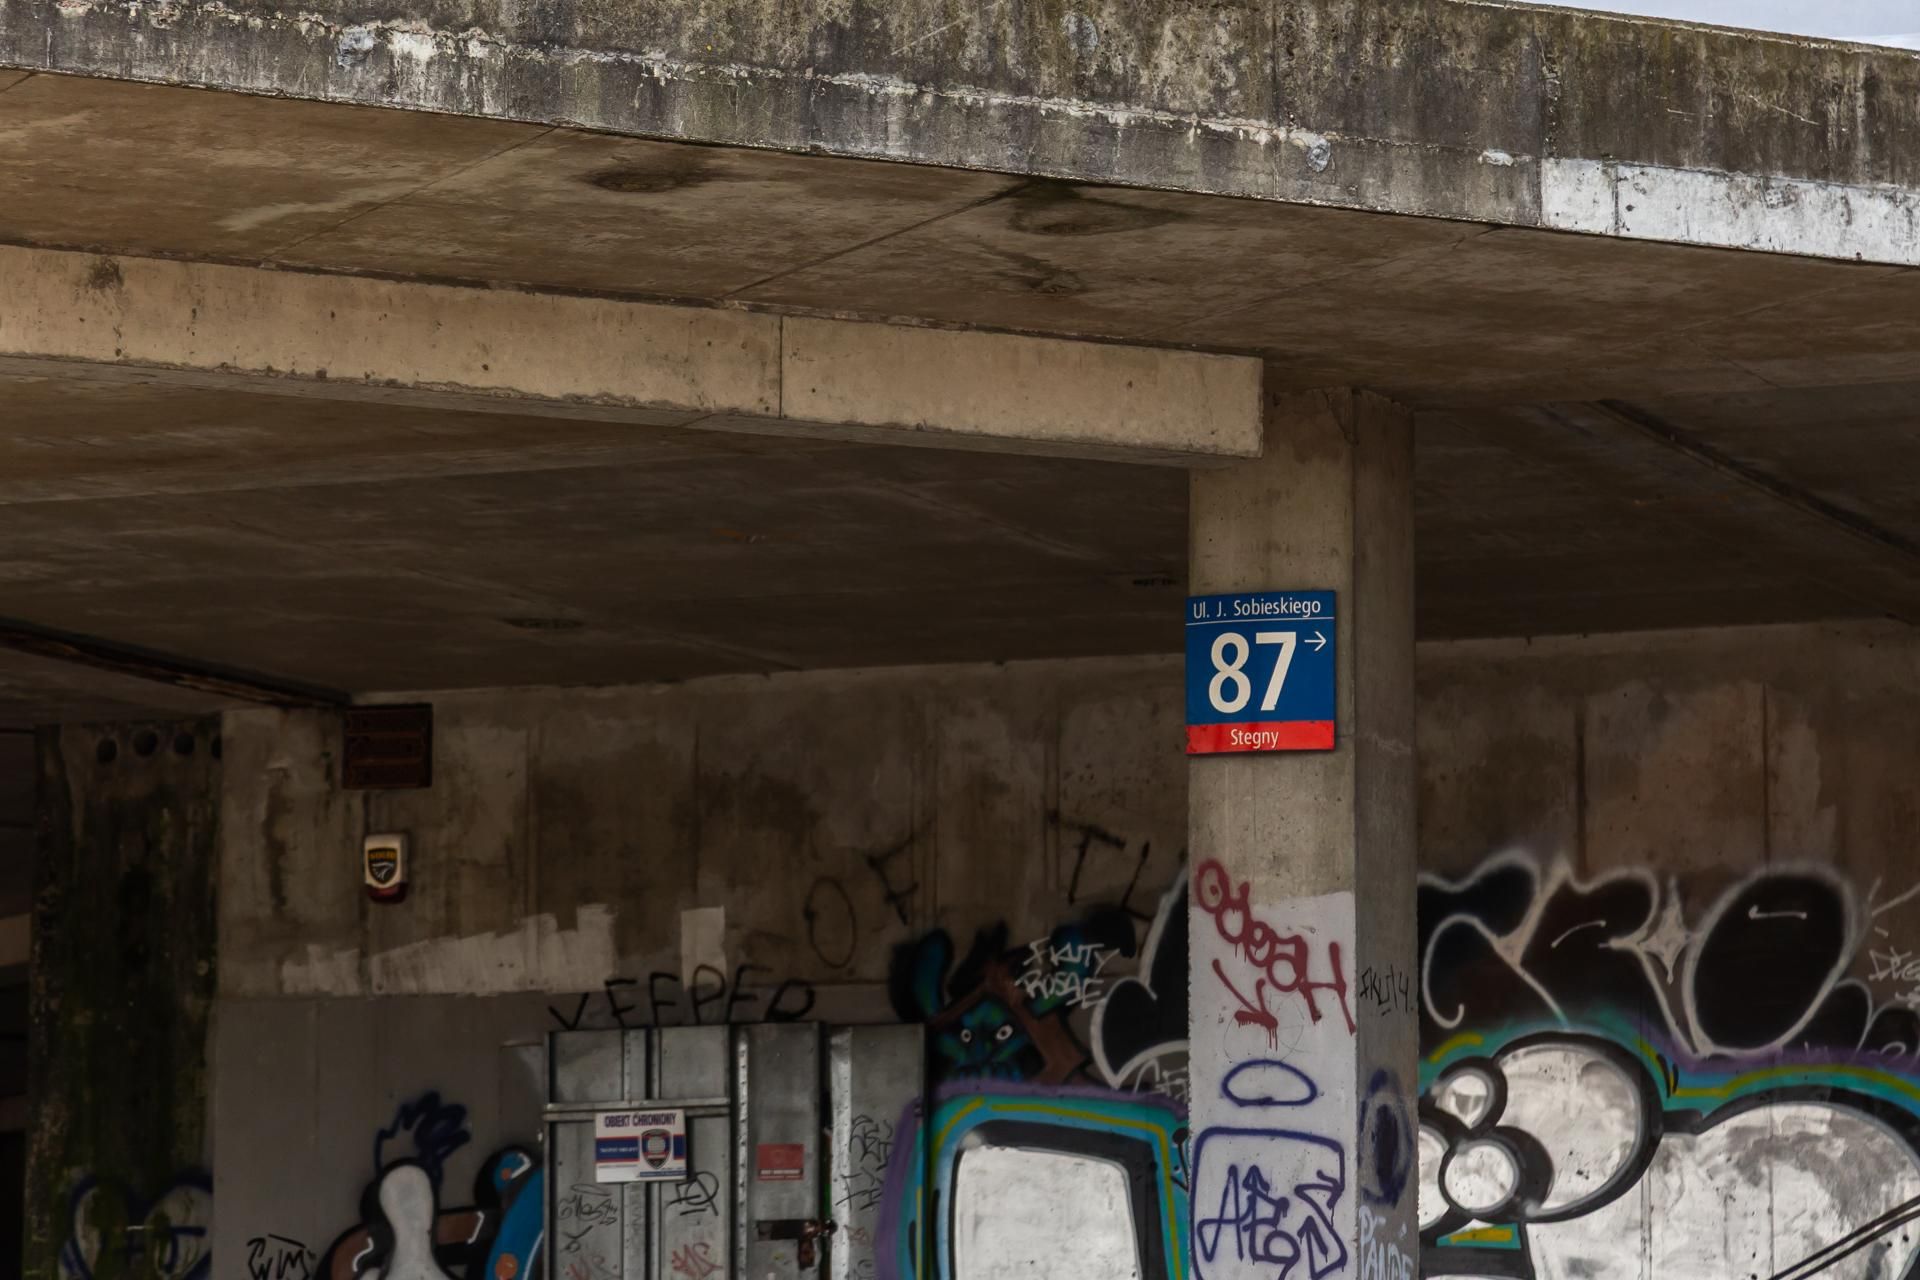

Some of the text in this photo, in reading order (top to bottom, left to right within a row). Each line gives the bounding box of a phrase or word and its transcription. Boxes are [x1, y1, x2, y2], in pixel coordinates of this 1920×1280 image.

[1193, 597, 1321, 619] Ul. J. Sobieskiego
[1208, 632, 1297, 713] 87
[1230, 728, 1279, 749] Stegny
